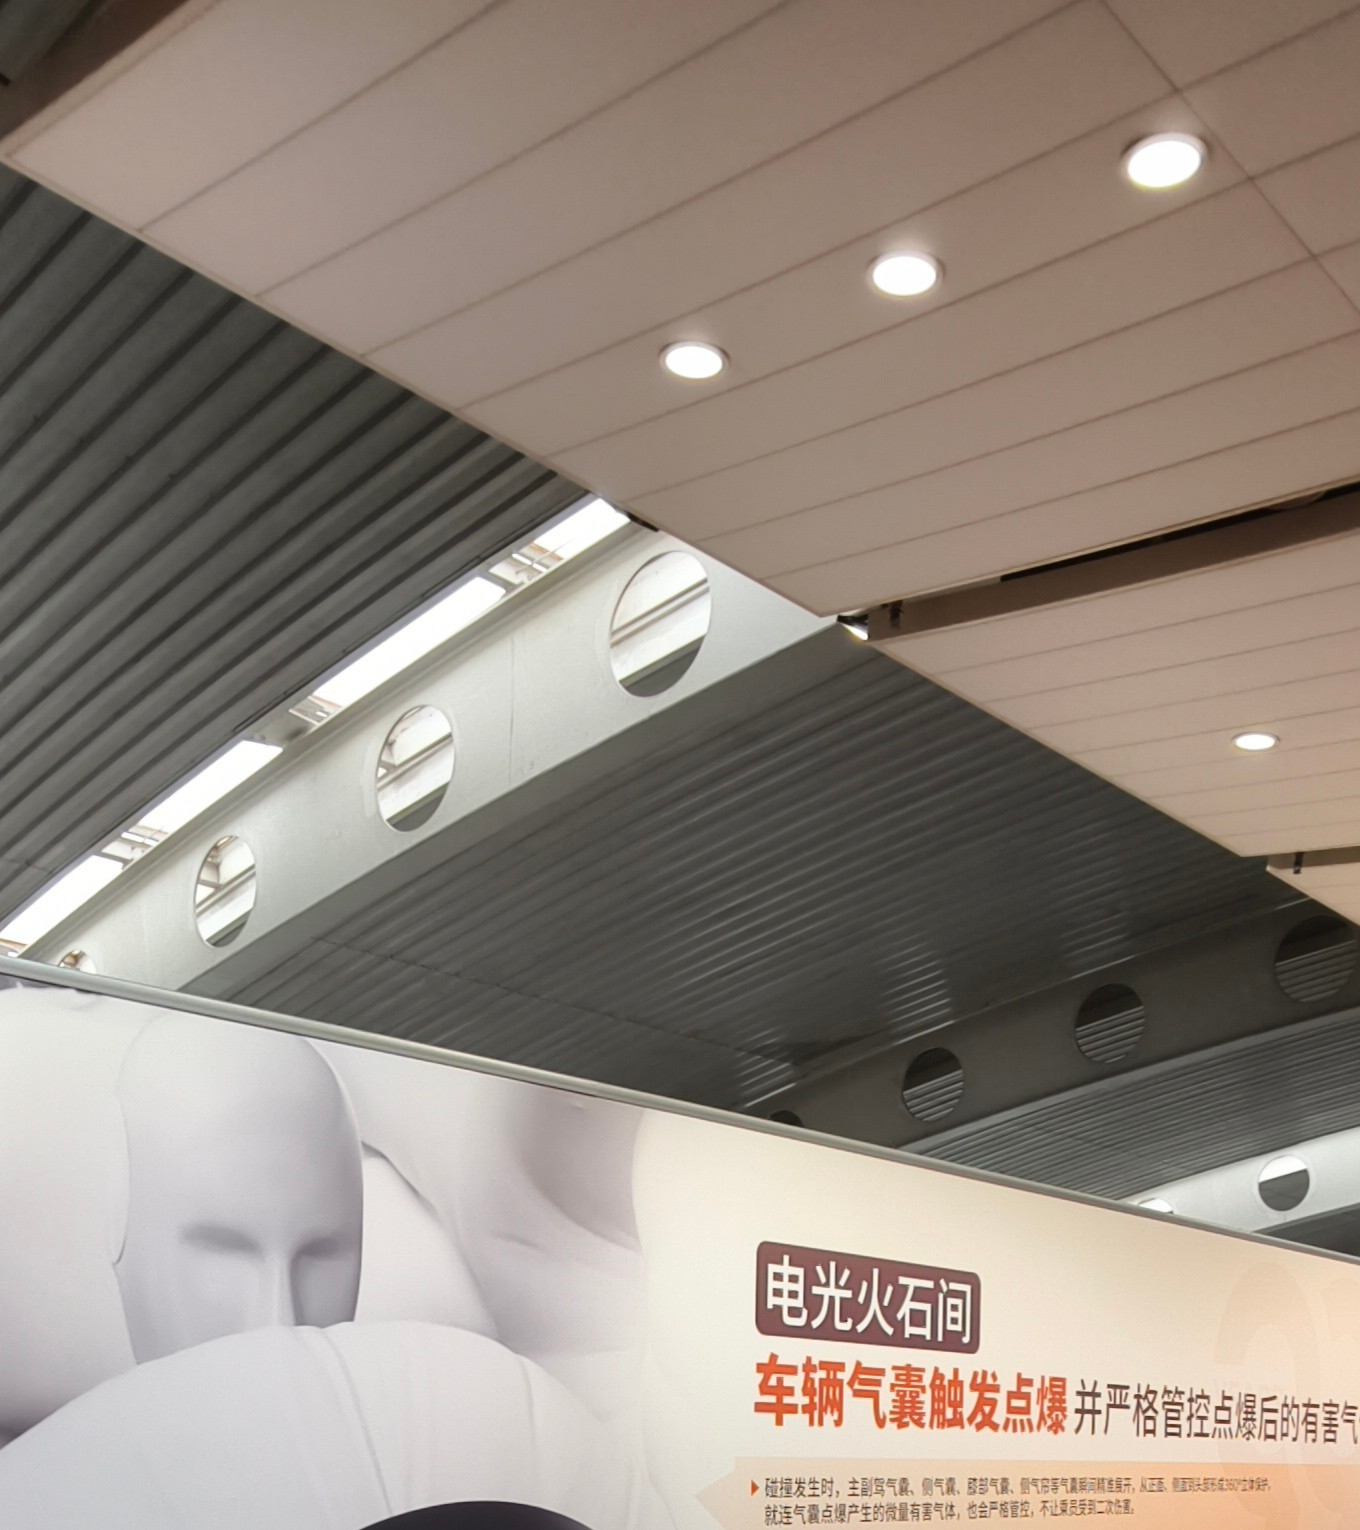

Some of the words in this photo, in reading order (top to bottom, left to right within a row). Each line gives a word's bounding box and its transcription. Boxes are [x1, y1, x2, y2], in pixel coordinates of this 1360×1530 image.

[766, 1253, 972, 1344] 电光火石间
